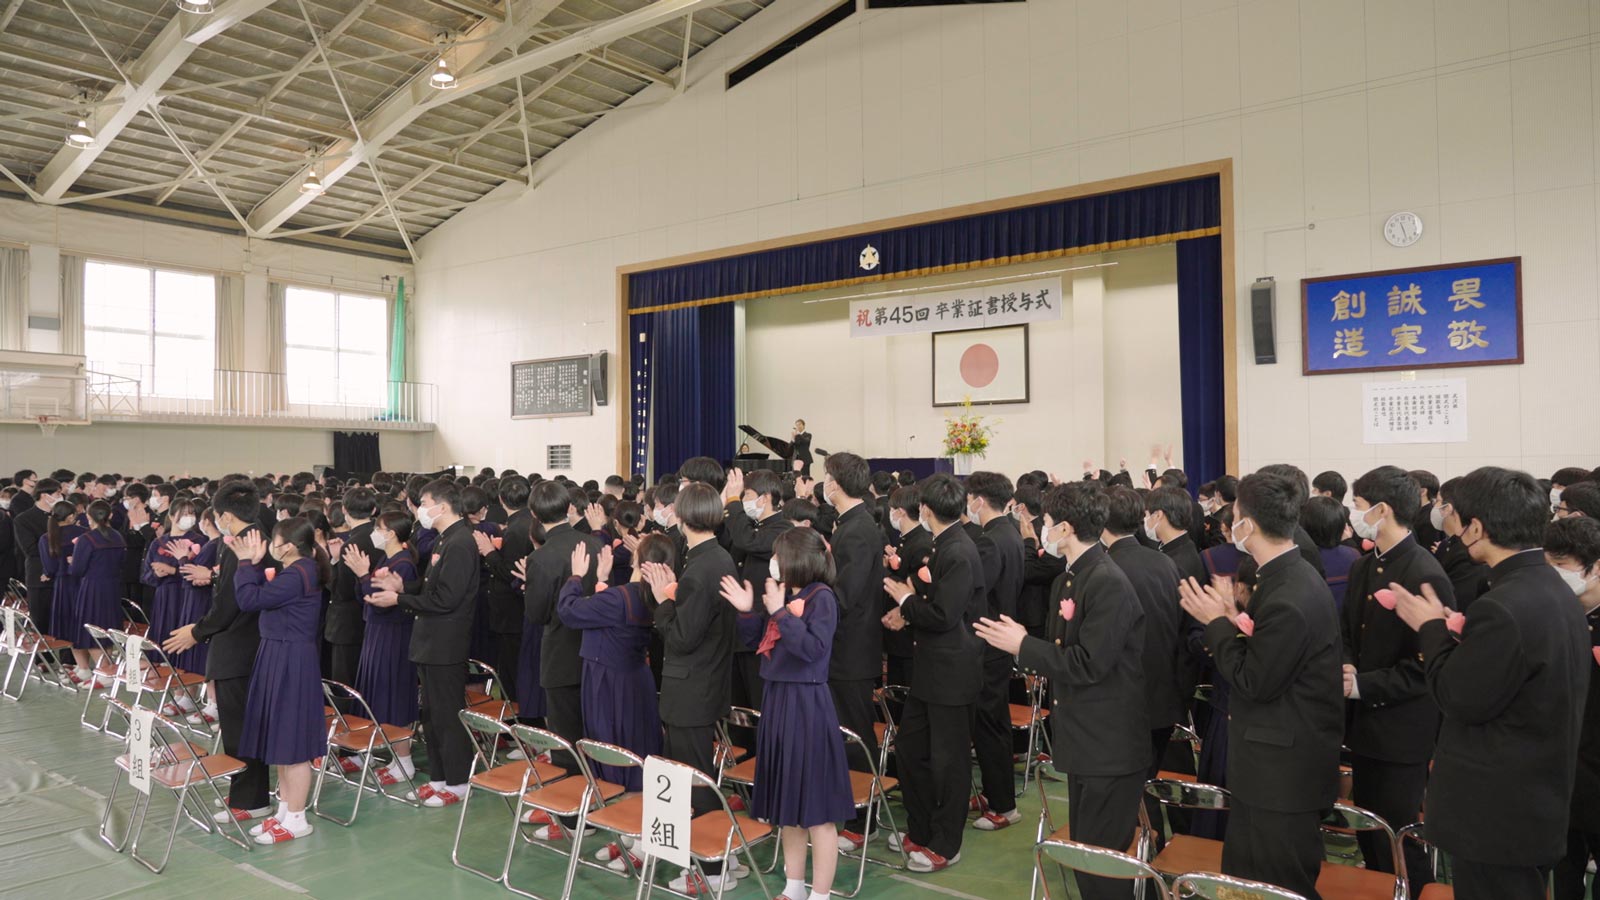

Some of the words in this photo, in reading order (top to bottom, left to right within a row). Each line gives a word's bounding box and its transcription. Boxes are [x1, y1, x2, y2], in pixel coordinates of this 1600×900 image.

[935, 288, 1052, 321] 卒業証書授与式
[1331, 290, 1369, 359] 創造
[1387, 283, 1427, 355] 誠実
[1448, 277, 1489, 350] 畏敬
[650, 774, 680, 850] 2組
